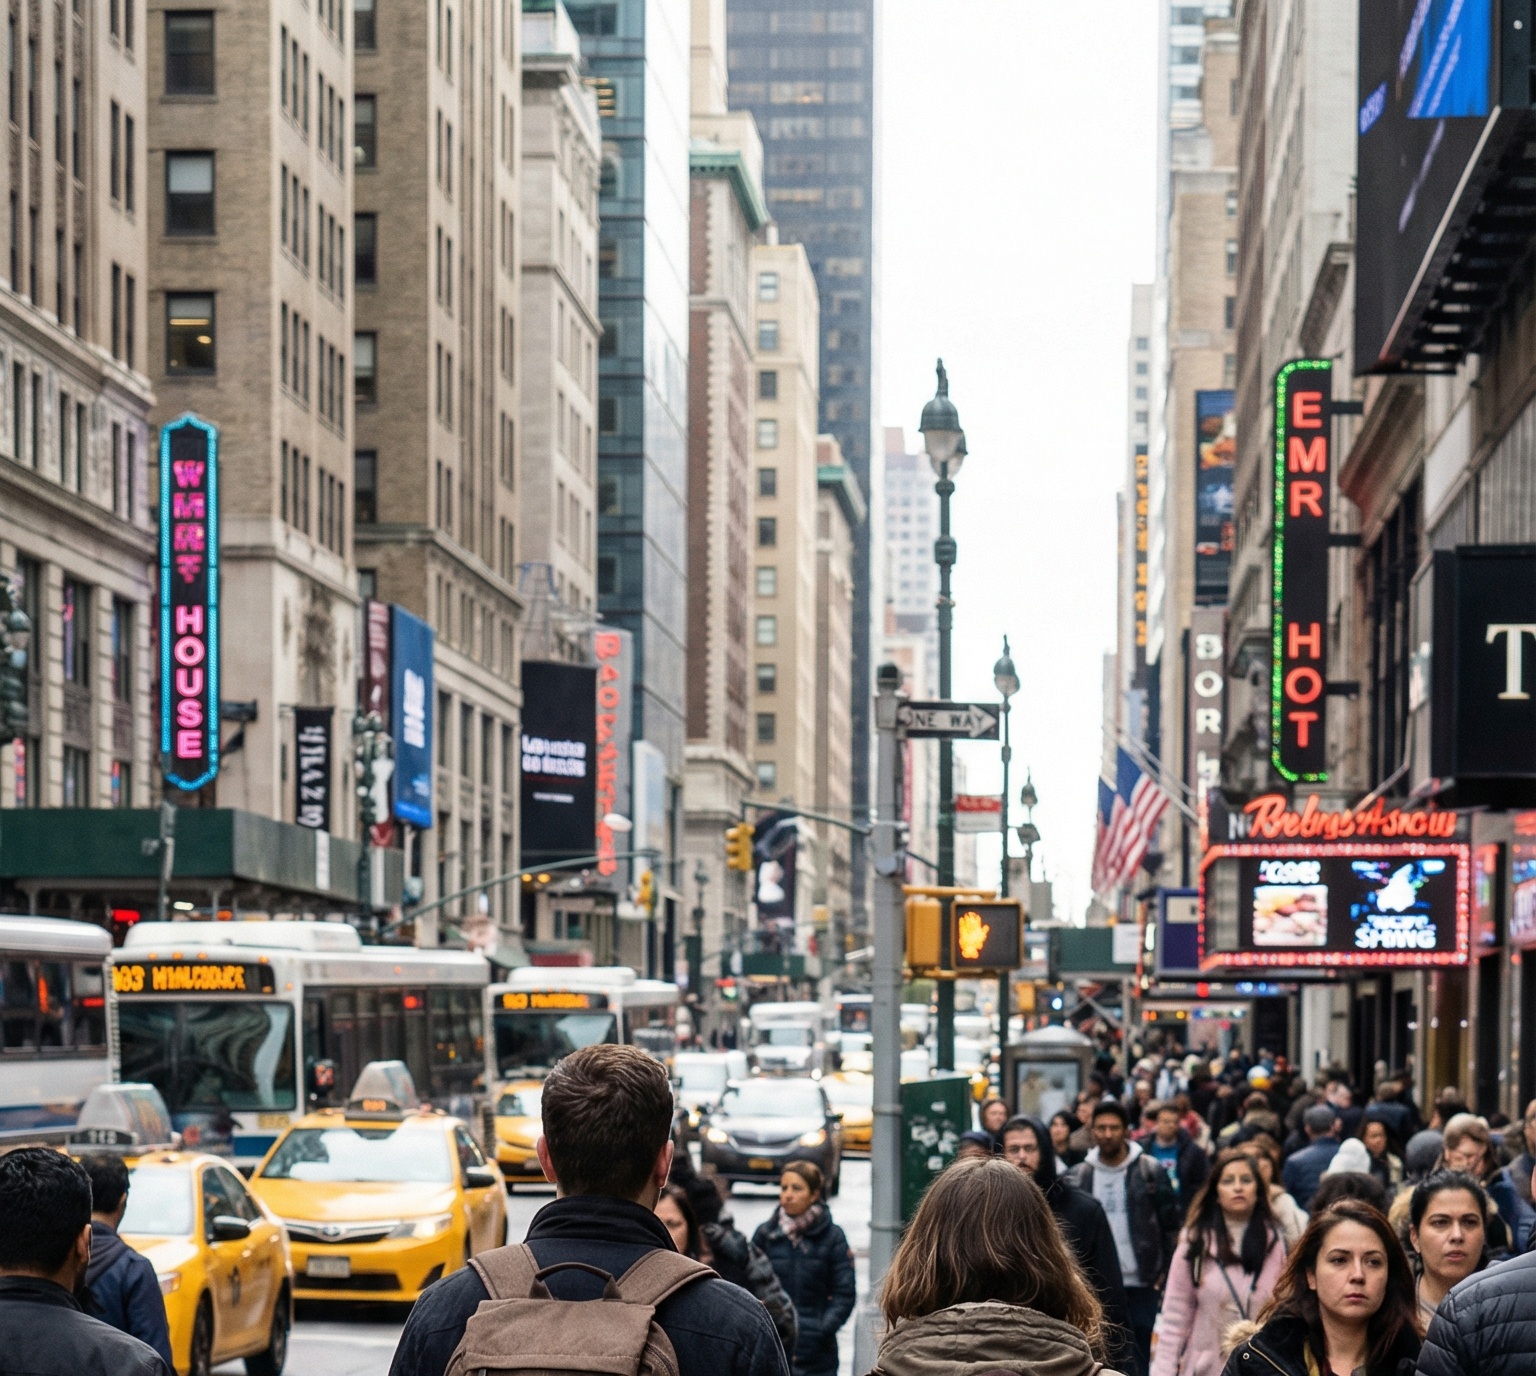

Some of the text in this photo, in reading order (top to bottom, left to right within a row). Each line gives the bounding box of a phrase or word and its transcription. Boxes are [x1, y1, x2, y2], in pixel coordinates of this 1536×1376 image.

[1285, 391, 1327, 748] EMR HOT
[174, 604, 205, 759] HOUSE
[950, 712, 984, 728] WAY
